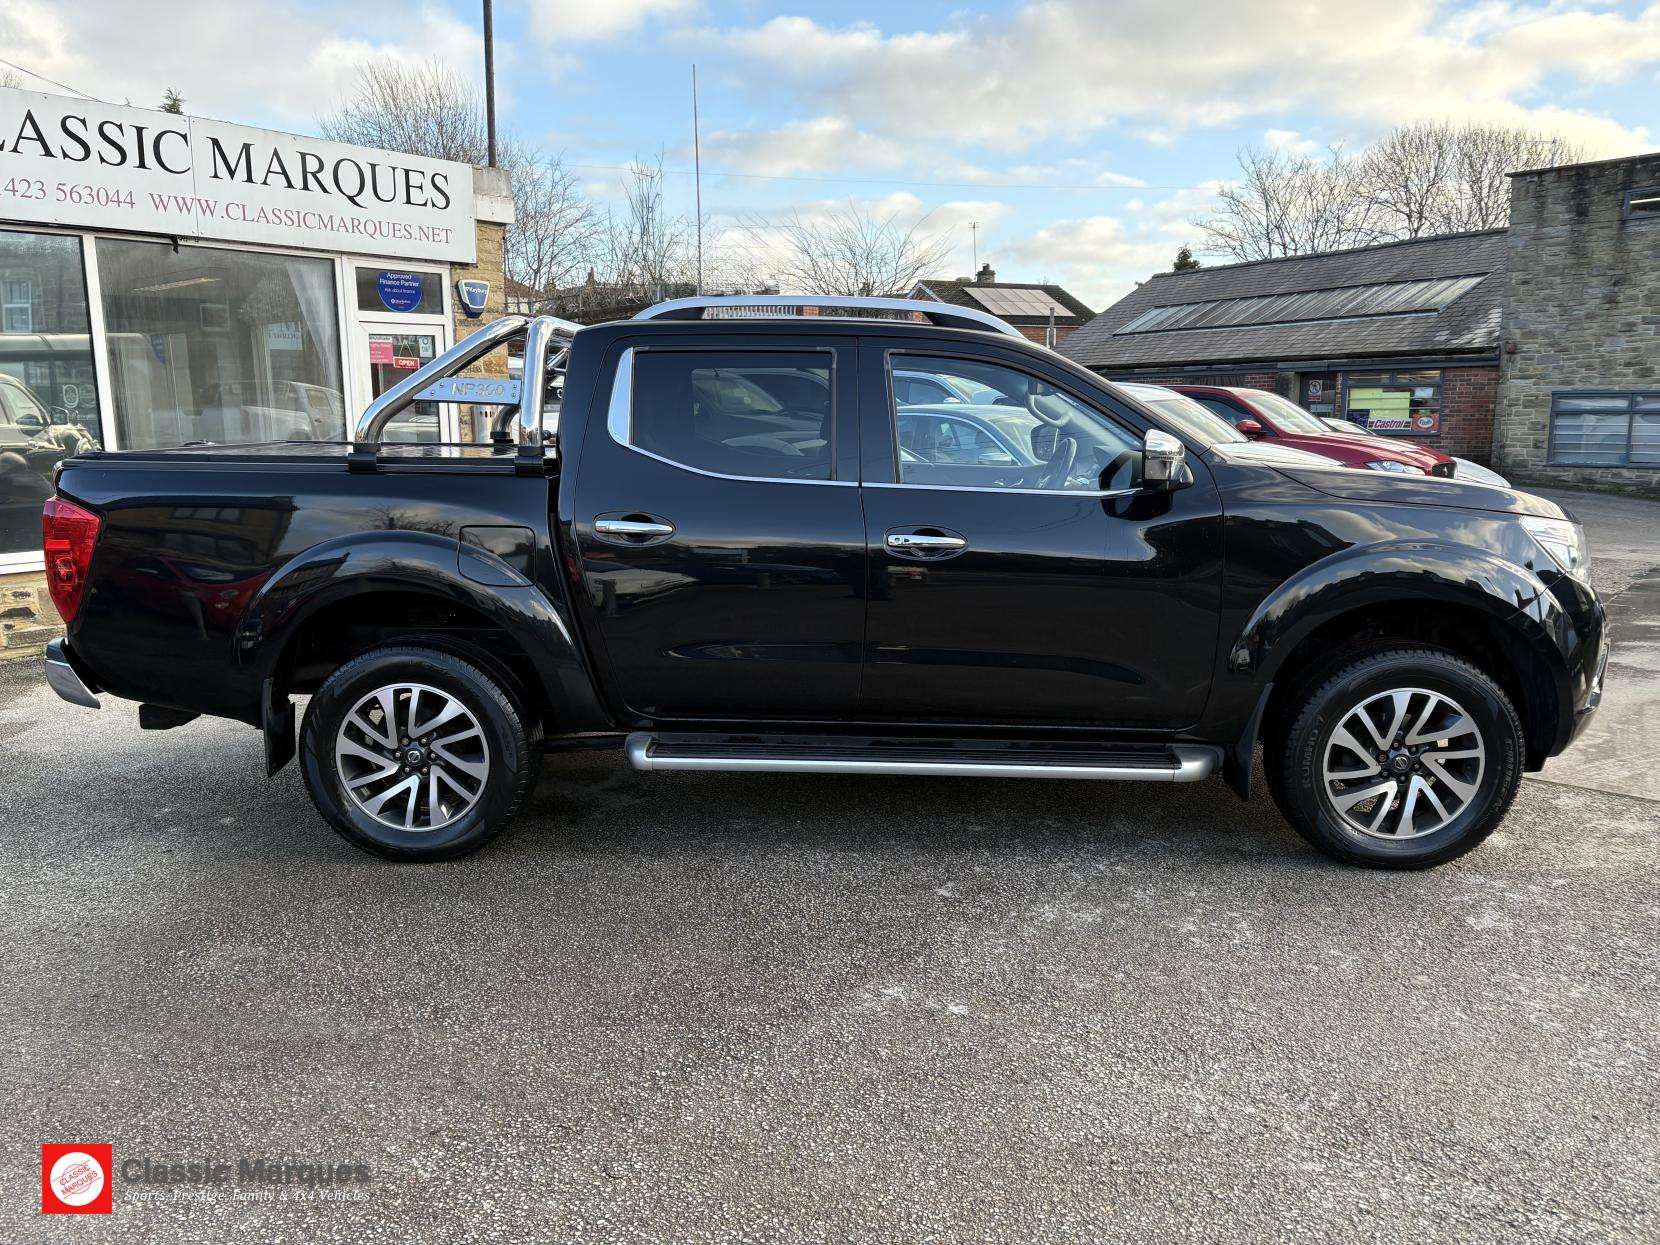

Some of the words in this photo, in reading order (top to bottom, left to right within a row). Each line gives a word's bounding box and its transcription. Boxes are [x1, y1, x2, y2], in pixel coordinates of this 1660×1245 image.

[0, 108, 191, 174] ASSIC
[206, 135, 452, 210] MARQUES
[0, 177, 47, 200] 423
[55, 181, 136, 210] 563044
[148, 191, 453, 244] WWW.CLASSICMARQUES.NET
[379, 278, 401, 286] Finance
[386, 272, 412, 280] Approved
[451, 382, 505, 397] NP300
[1374, 419, 1404, 429] Castrol
